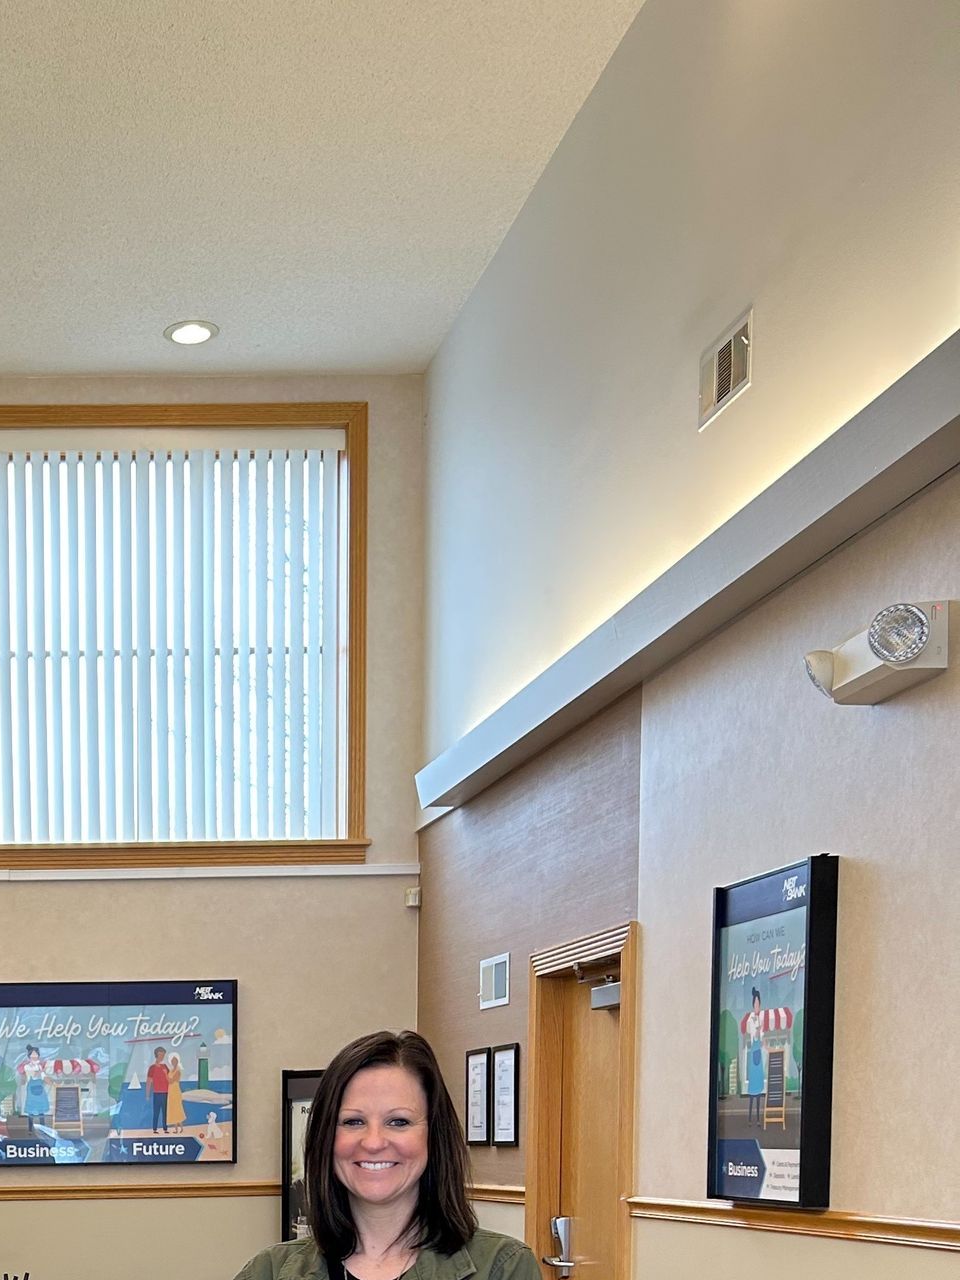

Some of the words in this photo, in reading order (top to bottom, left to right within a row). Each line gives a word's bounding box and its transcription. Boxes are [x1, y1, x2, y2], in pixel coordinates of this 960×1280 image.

[783, 876, 798, 891] NBT
[787, 884, 806, 900] BANK
[747, 933, 760, 943] HOW
[762, 929, 774, 941] CAN
[775, 926, 785, 937] WE
[728, 953, 750, 984] Help
[751, 950, 771, 977] You
[771, 943, 806, 981] Today?
[195, 986, 213, 994] NBT
[200, 991, 223, 1000] BANK
[34, 1013, 81, 1044] Help
[86, 1014, 128, 1039] You
[127, 1013, 199, 1047] Today?
[6, 1144, 75, 1159] Business
[132, 1142, 185, 1157] Future
[728, 1161, 758, 1177] Business
